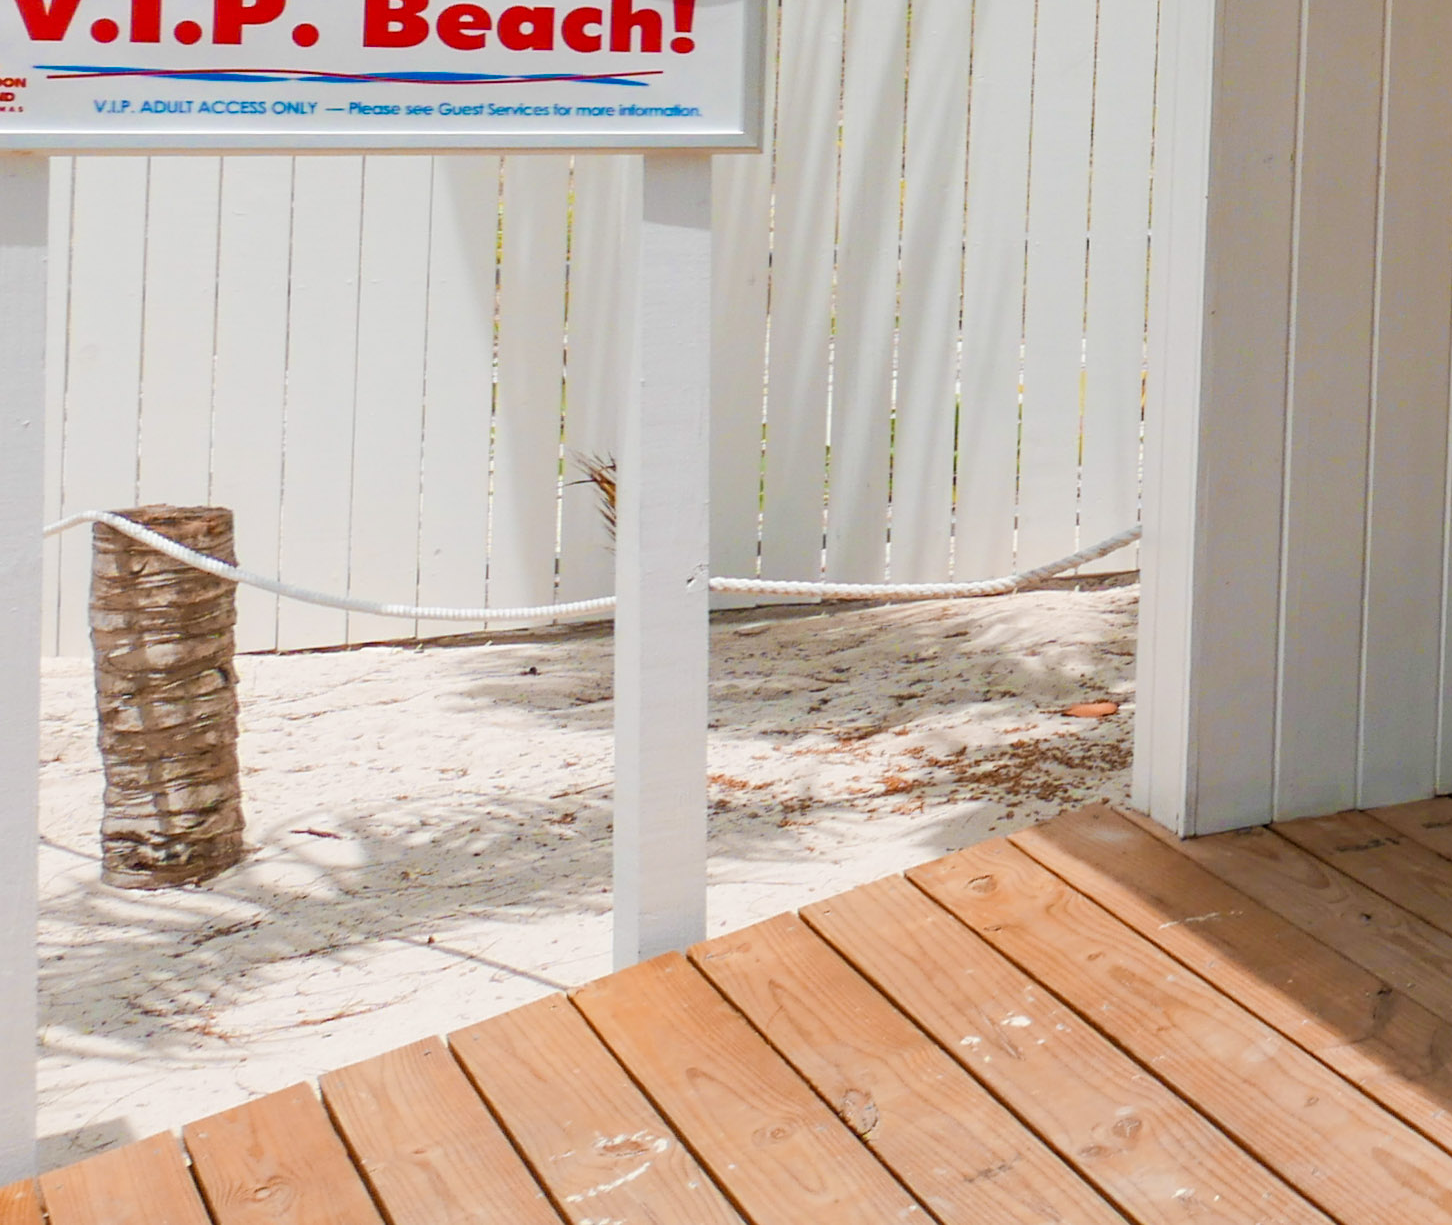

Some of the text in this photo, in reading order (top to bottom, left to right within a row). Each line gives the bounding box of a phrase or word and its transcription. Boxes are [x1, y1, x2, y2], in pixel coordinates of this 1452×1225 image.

[95, 99, 134, 113] V.I.P.
[138, 100, 194, 114] ADULT
[197, 100, 267, 115] ACCESS
[270, 101, 317, 115] ONLY
[349, 101, 401, 115] Please
[405, 105, 434, 116] see
[438, 102, 483, 116] Guest
[487, 102, 549, 117] Services
[553, 103, 573, 117] for
[576, 106, 615, 117] more
[618, 103, 703, 118] information.
